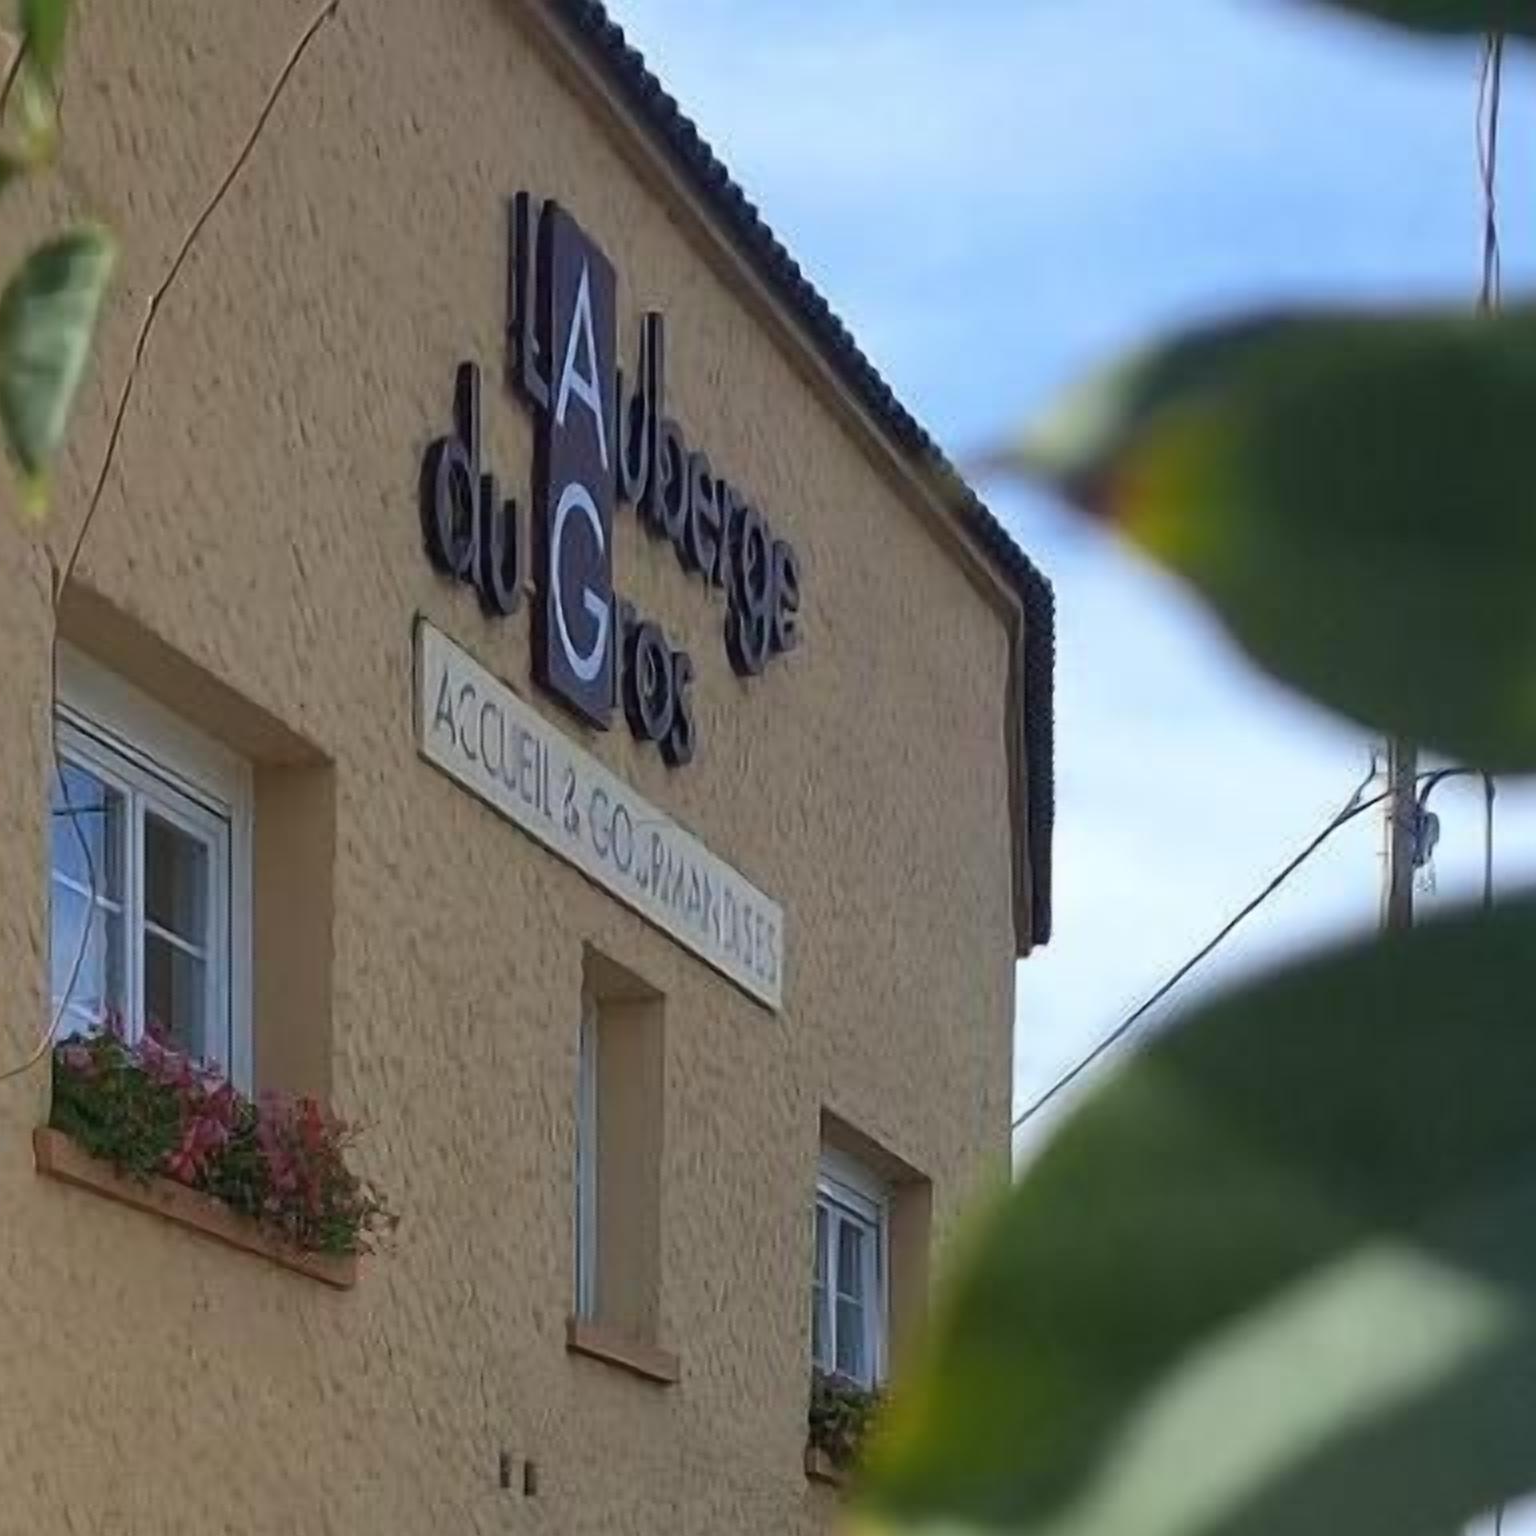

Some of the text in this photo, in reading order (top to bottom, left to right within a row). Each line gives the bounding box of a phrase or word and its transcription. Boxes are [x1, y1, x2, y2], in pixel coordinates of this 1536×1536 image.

[419, 362, 521, 616] du
[434, 662, 553, 821] ACCUEIL
[562, 766, 580, 837] &
